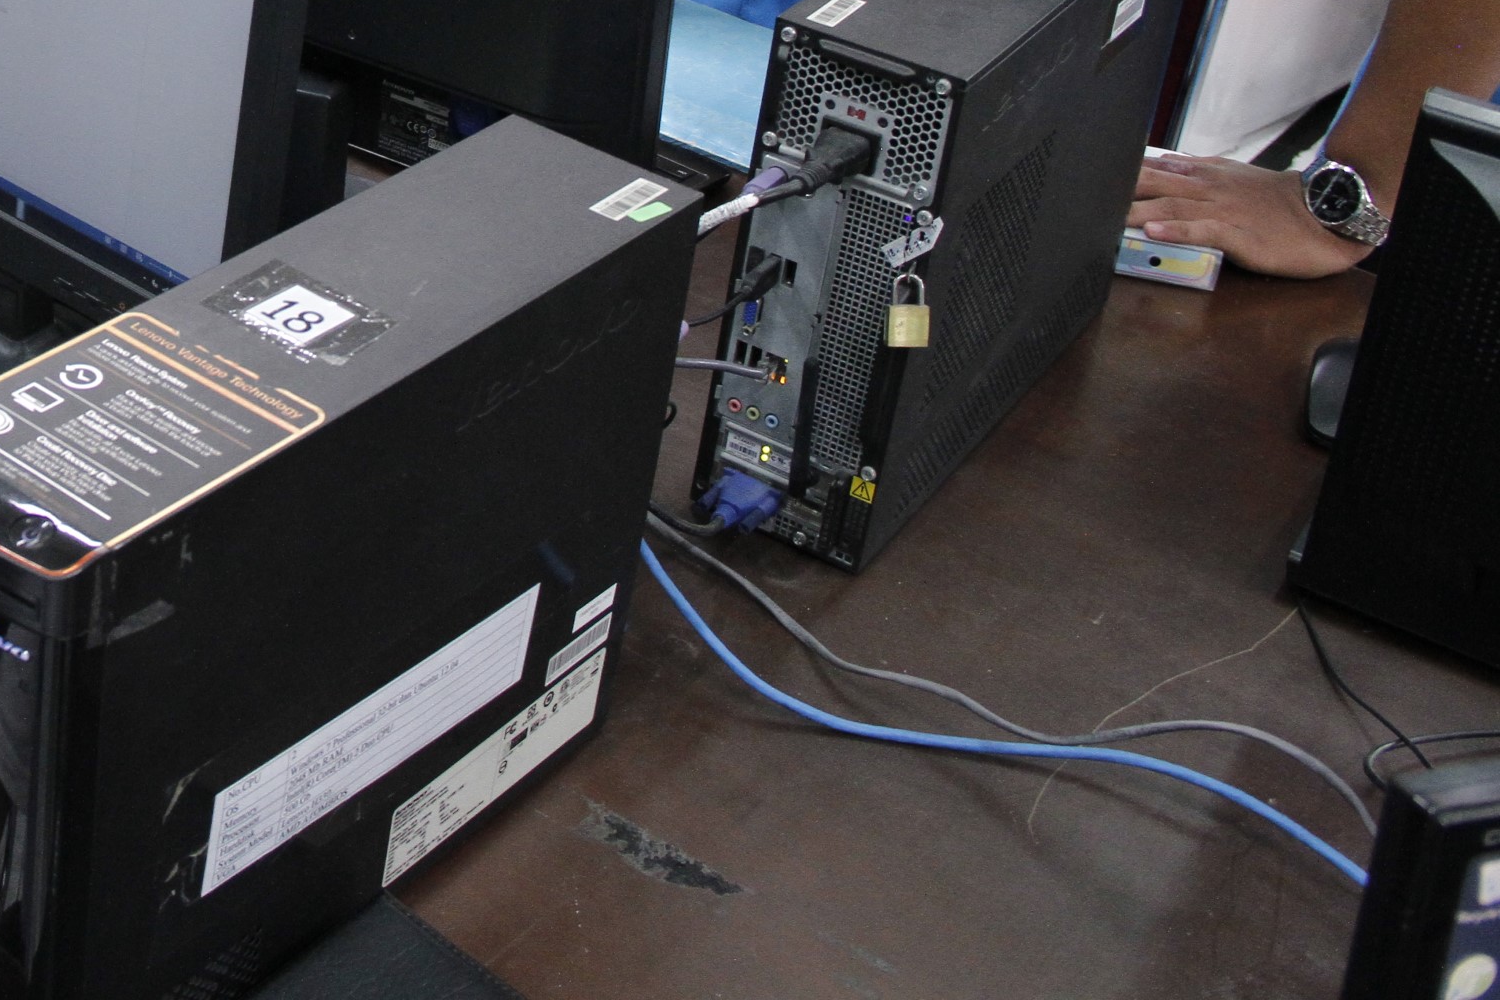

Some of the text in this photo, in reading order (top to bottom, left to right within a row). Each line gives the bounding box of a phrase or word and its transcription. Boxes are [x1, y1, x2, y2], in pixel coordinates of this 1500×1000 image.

[260, 298, 326, 337] 18
[102, 339, 130, 356] Lenovo
[130, 322, 176, 350] Lenovo
[178, 347, 227, 378] Vantage
[230, 376, 302, 418] Technology
[291, 750, 324, 774] Windows
[333, 713, 376, 747] Professional
[322, 747, 343, 766] RAM
[224, 807, 257, 829] Memory
[225, 804, 239, 817] OS
